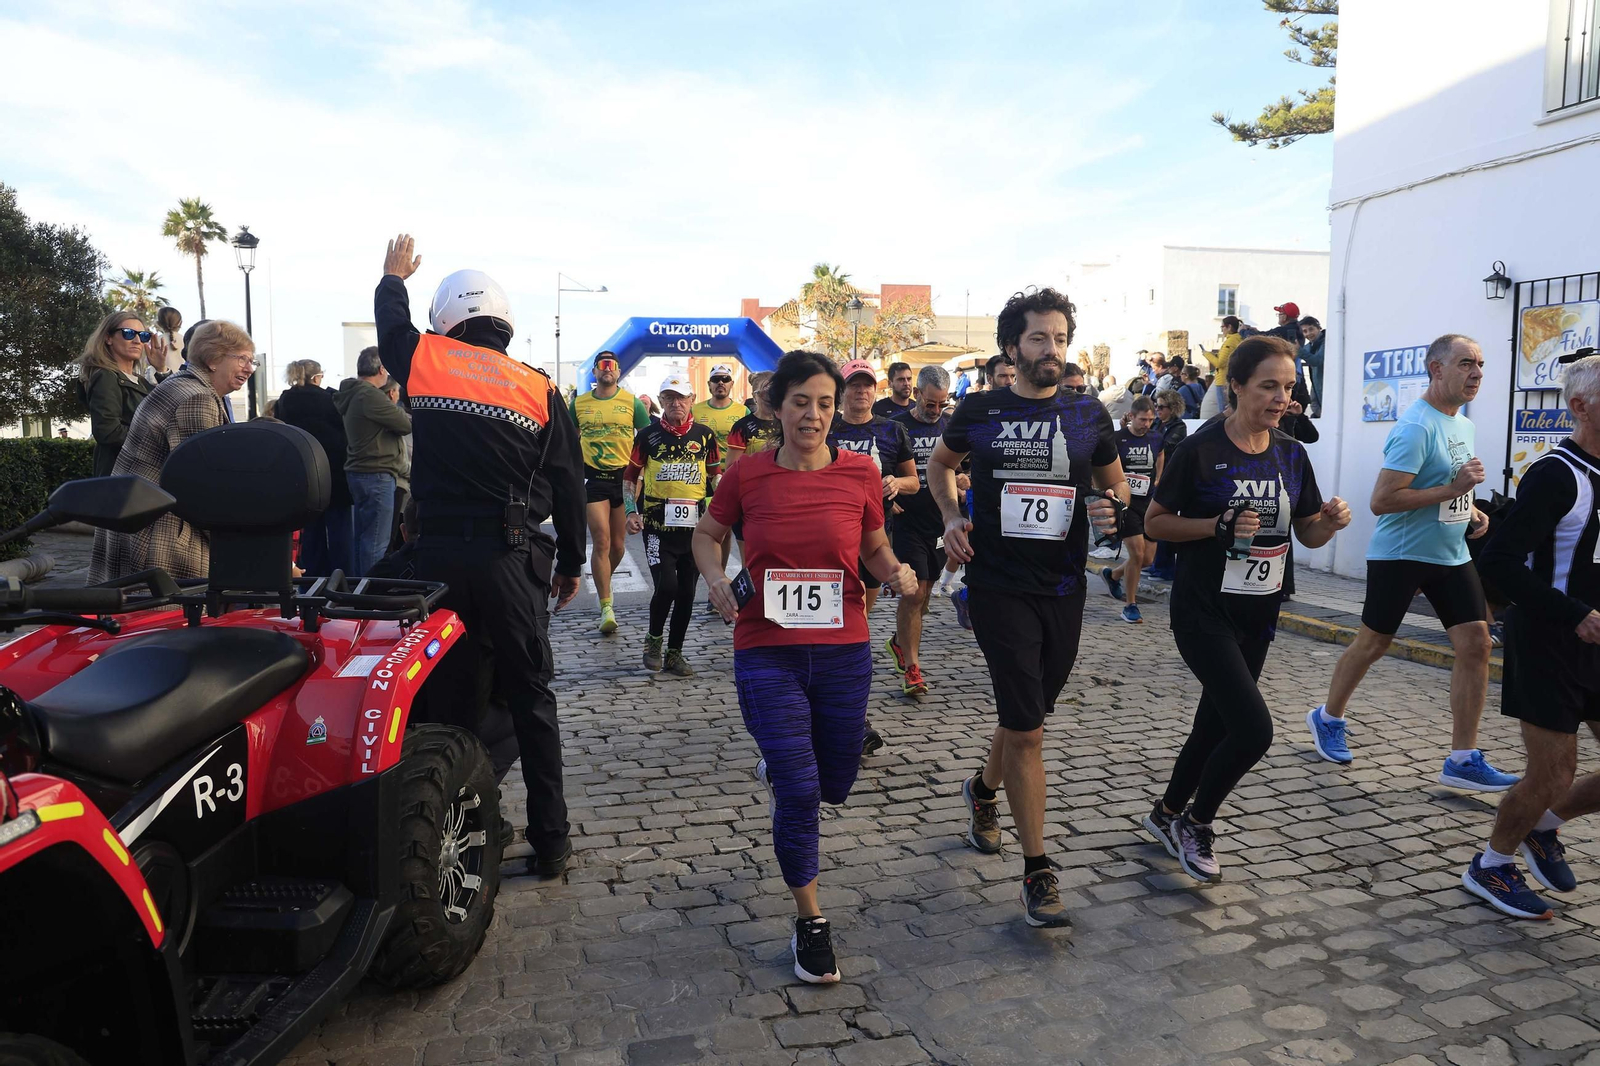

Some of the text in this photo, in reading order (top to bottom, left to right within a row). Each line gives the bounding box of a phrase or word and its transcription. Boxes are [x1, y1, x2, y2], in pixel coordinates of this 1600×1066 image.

[649, 321, 730, 338] Cruzcampo
[1560, 326, 1594, 352] Fish
[677, 339, 702, 352] 0.0
[467, 361, 502, 376] CIVIL
[1382, 347, 1427, 377] TERR
[1534, 362, 1548, 386] &
[1520, 410, 1554, 430] Take
[996, 421, 1051, 440] XVI
[1517, 436, 1546, 444] PARA
[991, 441, 1049, 449] CARRERA DEL
[1003, 448, 1049, 457] ESTRECHO
[660, 463, 699, 473] SIERRA
[1232, 480, 1276, 498] XVI
[674, 505, 690, 519] 99
[1021, 498, 1049, 523] 78
[1264, 499, 1278, 507] DEL
[1449, 494, 1470, 513] 418
[1245, 559, 1271, 582] 79
[777, 584, 822, 611] 115
[361, 709, 382, 774] CIVIL
[193, 762, 245, 819] R-3
